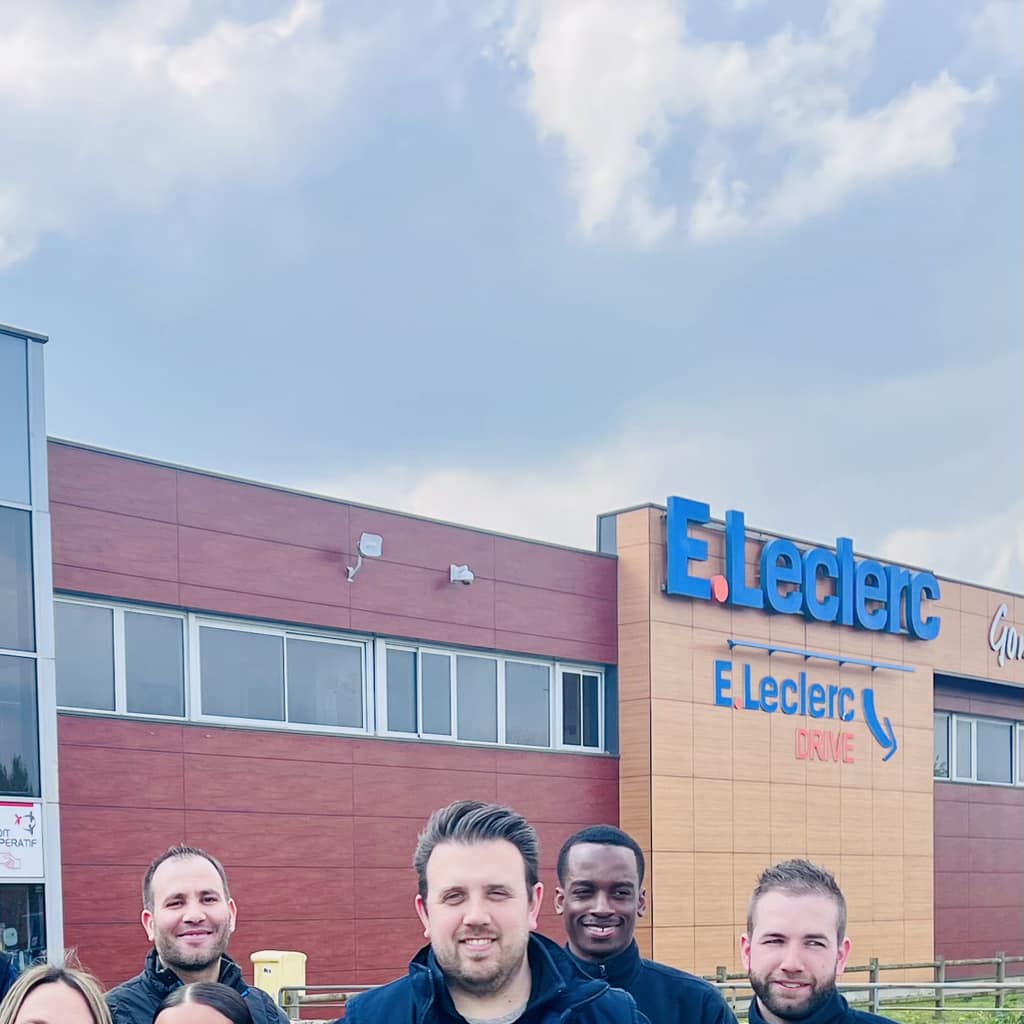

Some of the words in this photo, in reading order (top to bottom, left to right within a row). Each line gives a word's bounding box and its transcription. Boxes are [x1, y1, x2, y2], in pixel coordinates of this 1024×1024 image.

[667, 495, 941, 641] E.Leclerc
[713, 659, 855, 721] E.Leclerc
[795, 727, 855, 764] DRIVE
